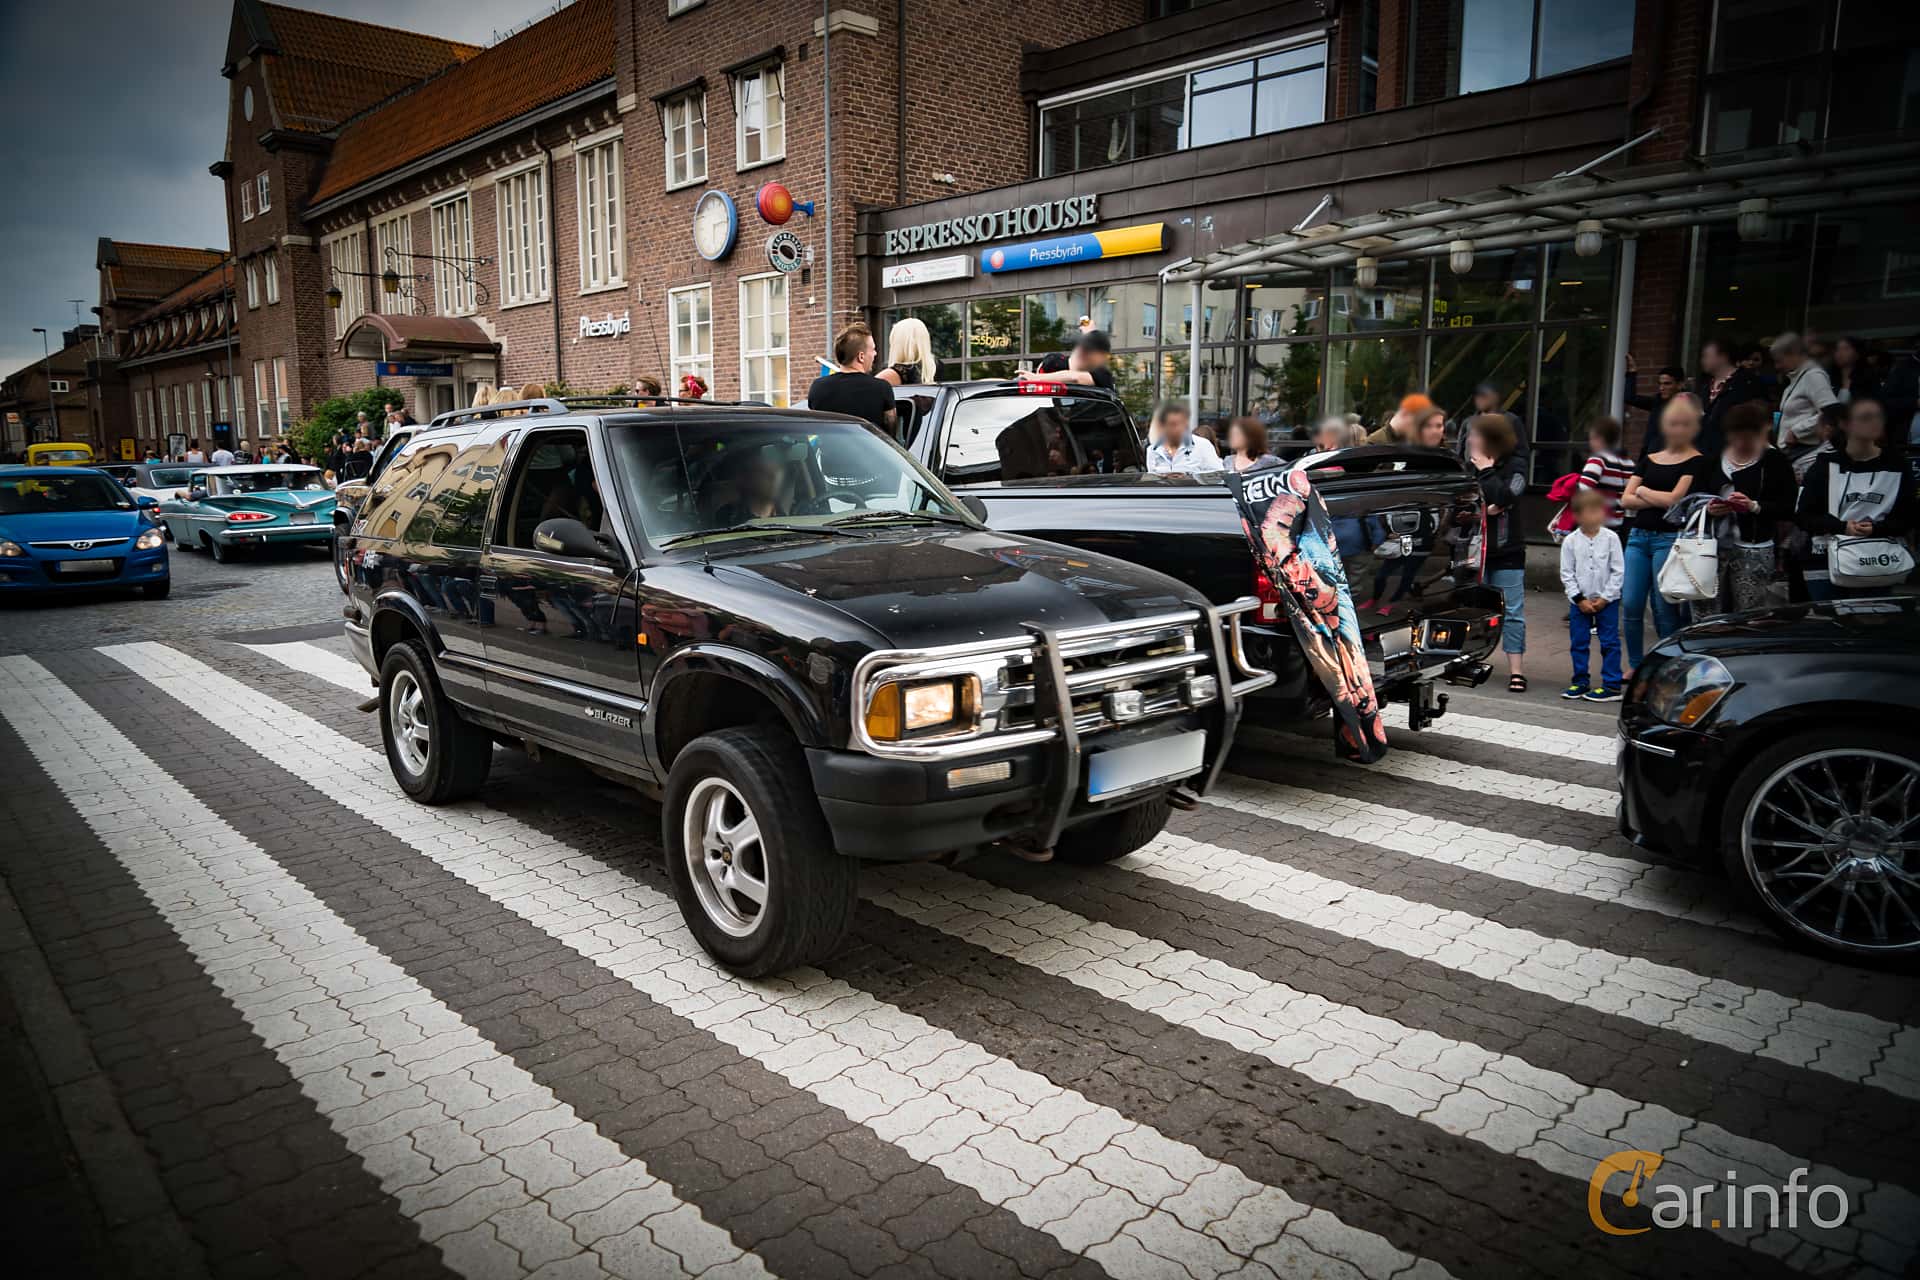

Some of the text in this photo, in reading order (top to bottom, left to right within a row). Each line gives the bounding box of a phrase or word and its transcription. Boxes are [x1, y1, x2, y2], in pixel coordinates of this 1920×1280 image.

[884, 194, 1097, 257] ESPRESSO HOUSE
[1029, 243, 1084, 263] Pressbyrån
[594, 709, 631, 728] BLAZER
